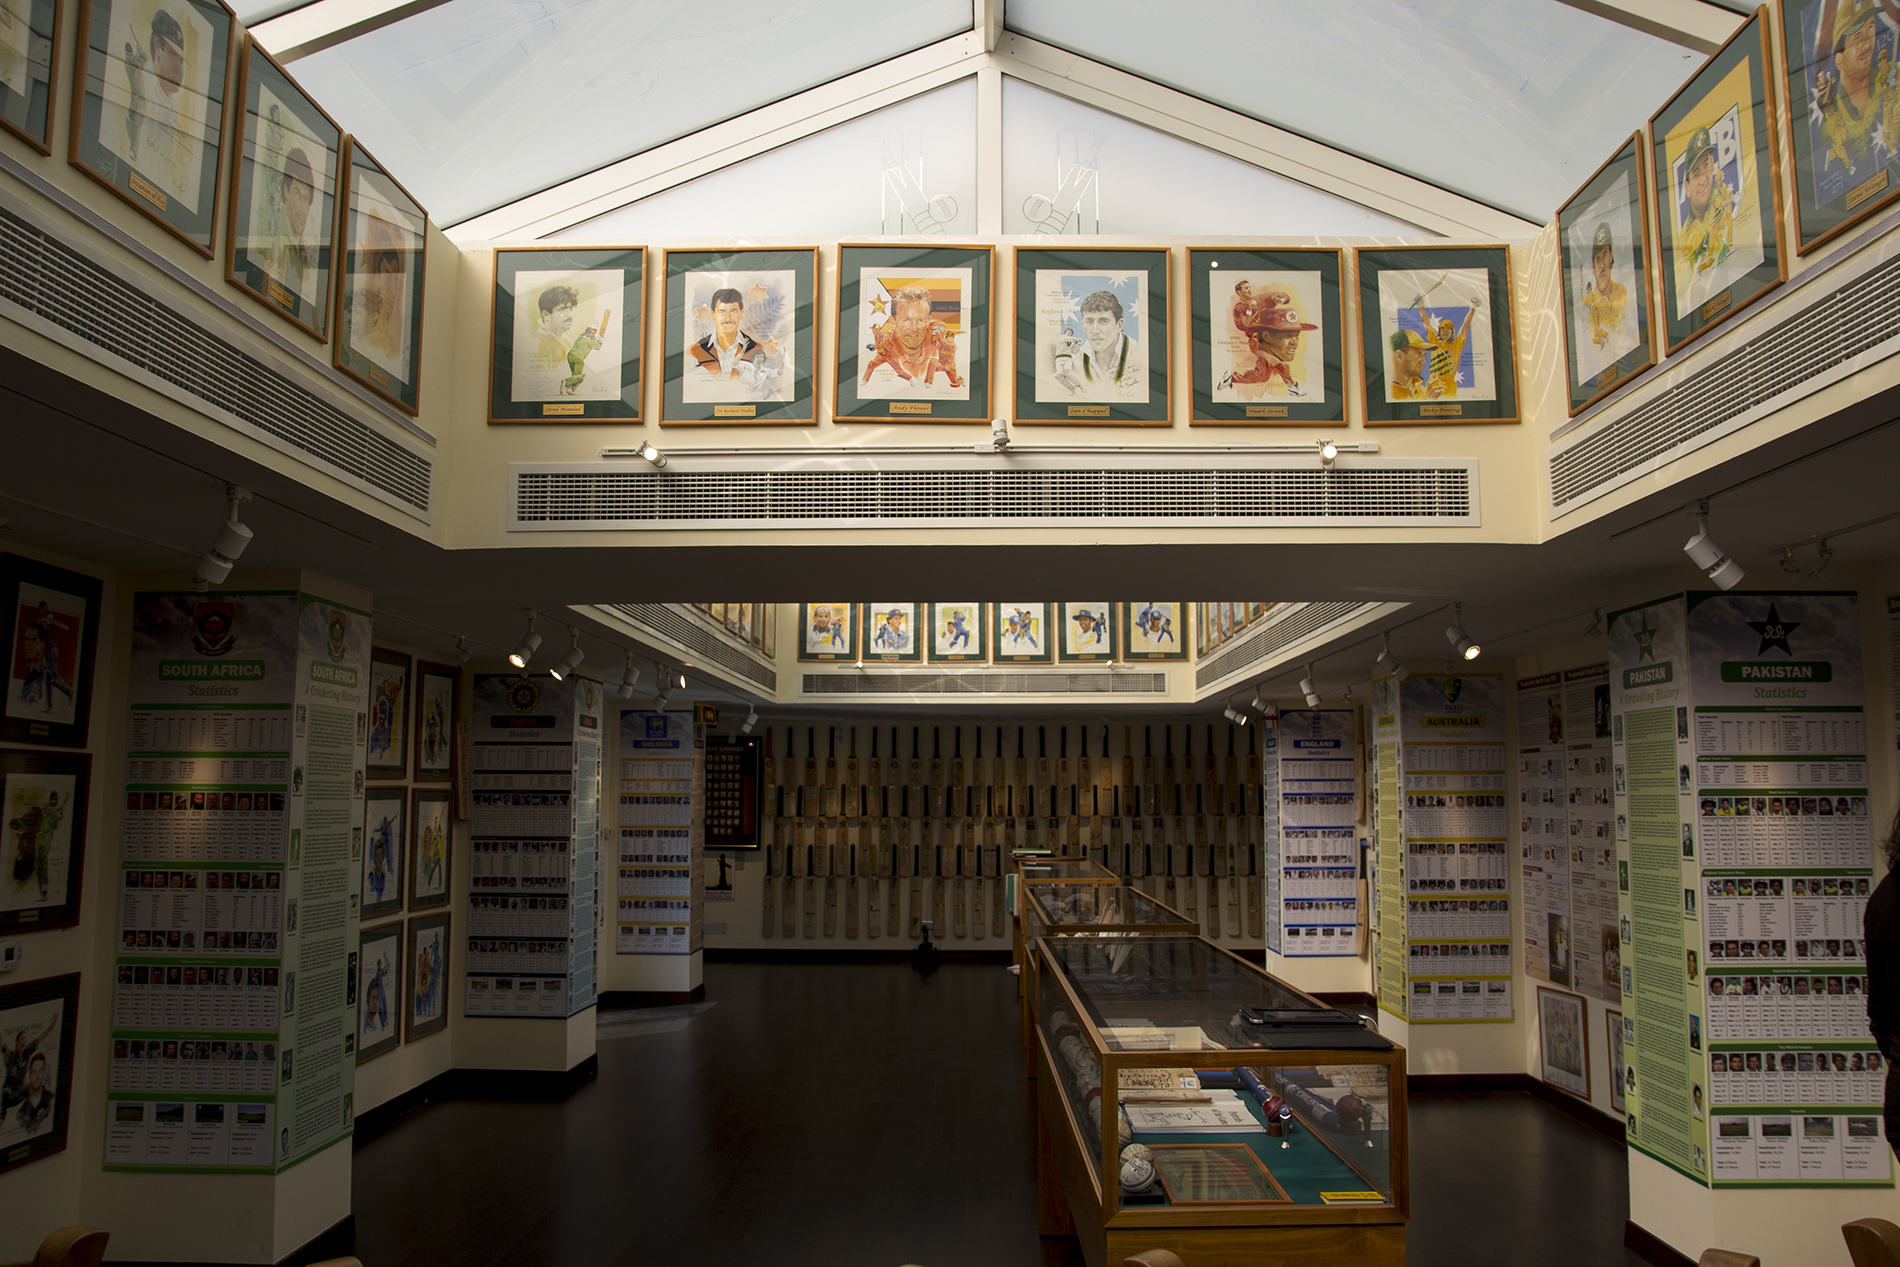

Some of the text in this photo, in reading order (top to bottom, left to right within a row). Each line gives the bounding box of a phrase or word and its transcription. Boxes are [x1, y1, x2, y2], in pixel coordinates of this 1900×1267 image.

[1876, 28, 1895, 51] 120
[1847, 190, 1864, 205] Steve
[161, 664, 262, 677] SOUTH AFRICA
[312, 664, 356, 685] SOUTH AFRICA
[1630, 666, 1666, 685] PAKISTAN
[1741, 666, 1812, 678] PAKISTAN
[188, 684, 239, 697] Statistics
[303, 683, 361, 706] A Cricketing History
[1619, 688, 1680, 705] A Cricketing History
[1753, 686, 1808, 699] Statistics
[509, 718, 537, 726] INDIA
[1426, 717, 1481, 726] AUSTRALIA
[508, 730, 540, 738] Statistics
[1439, 730, 1472, 738] Statistics
